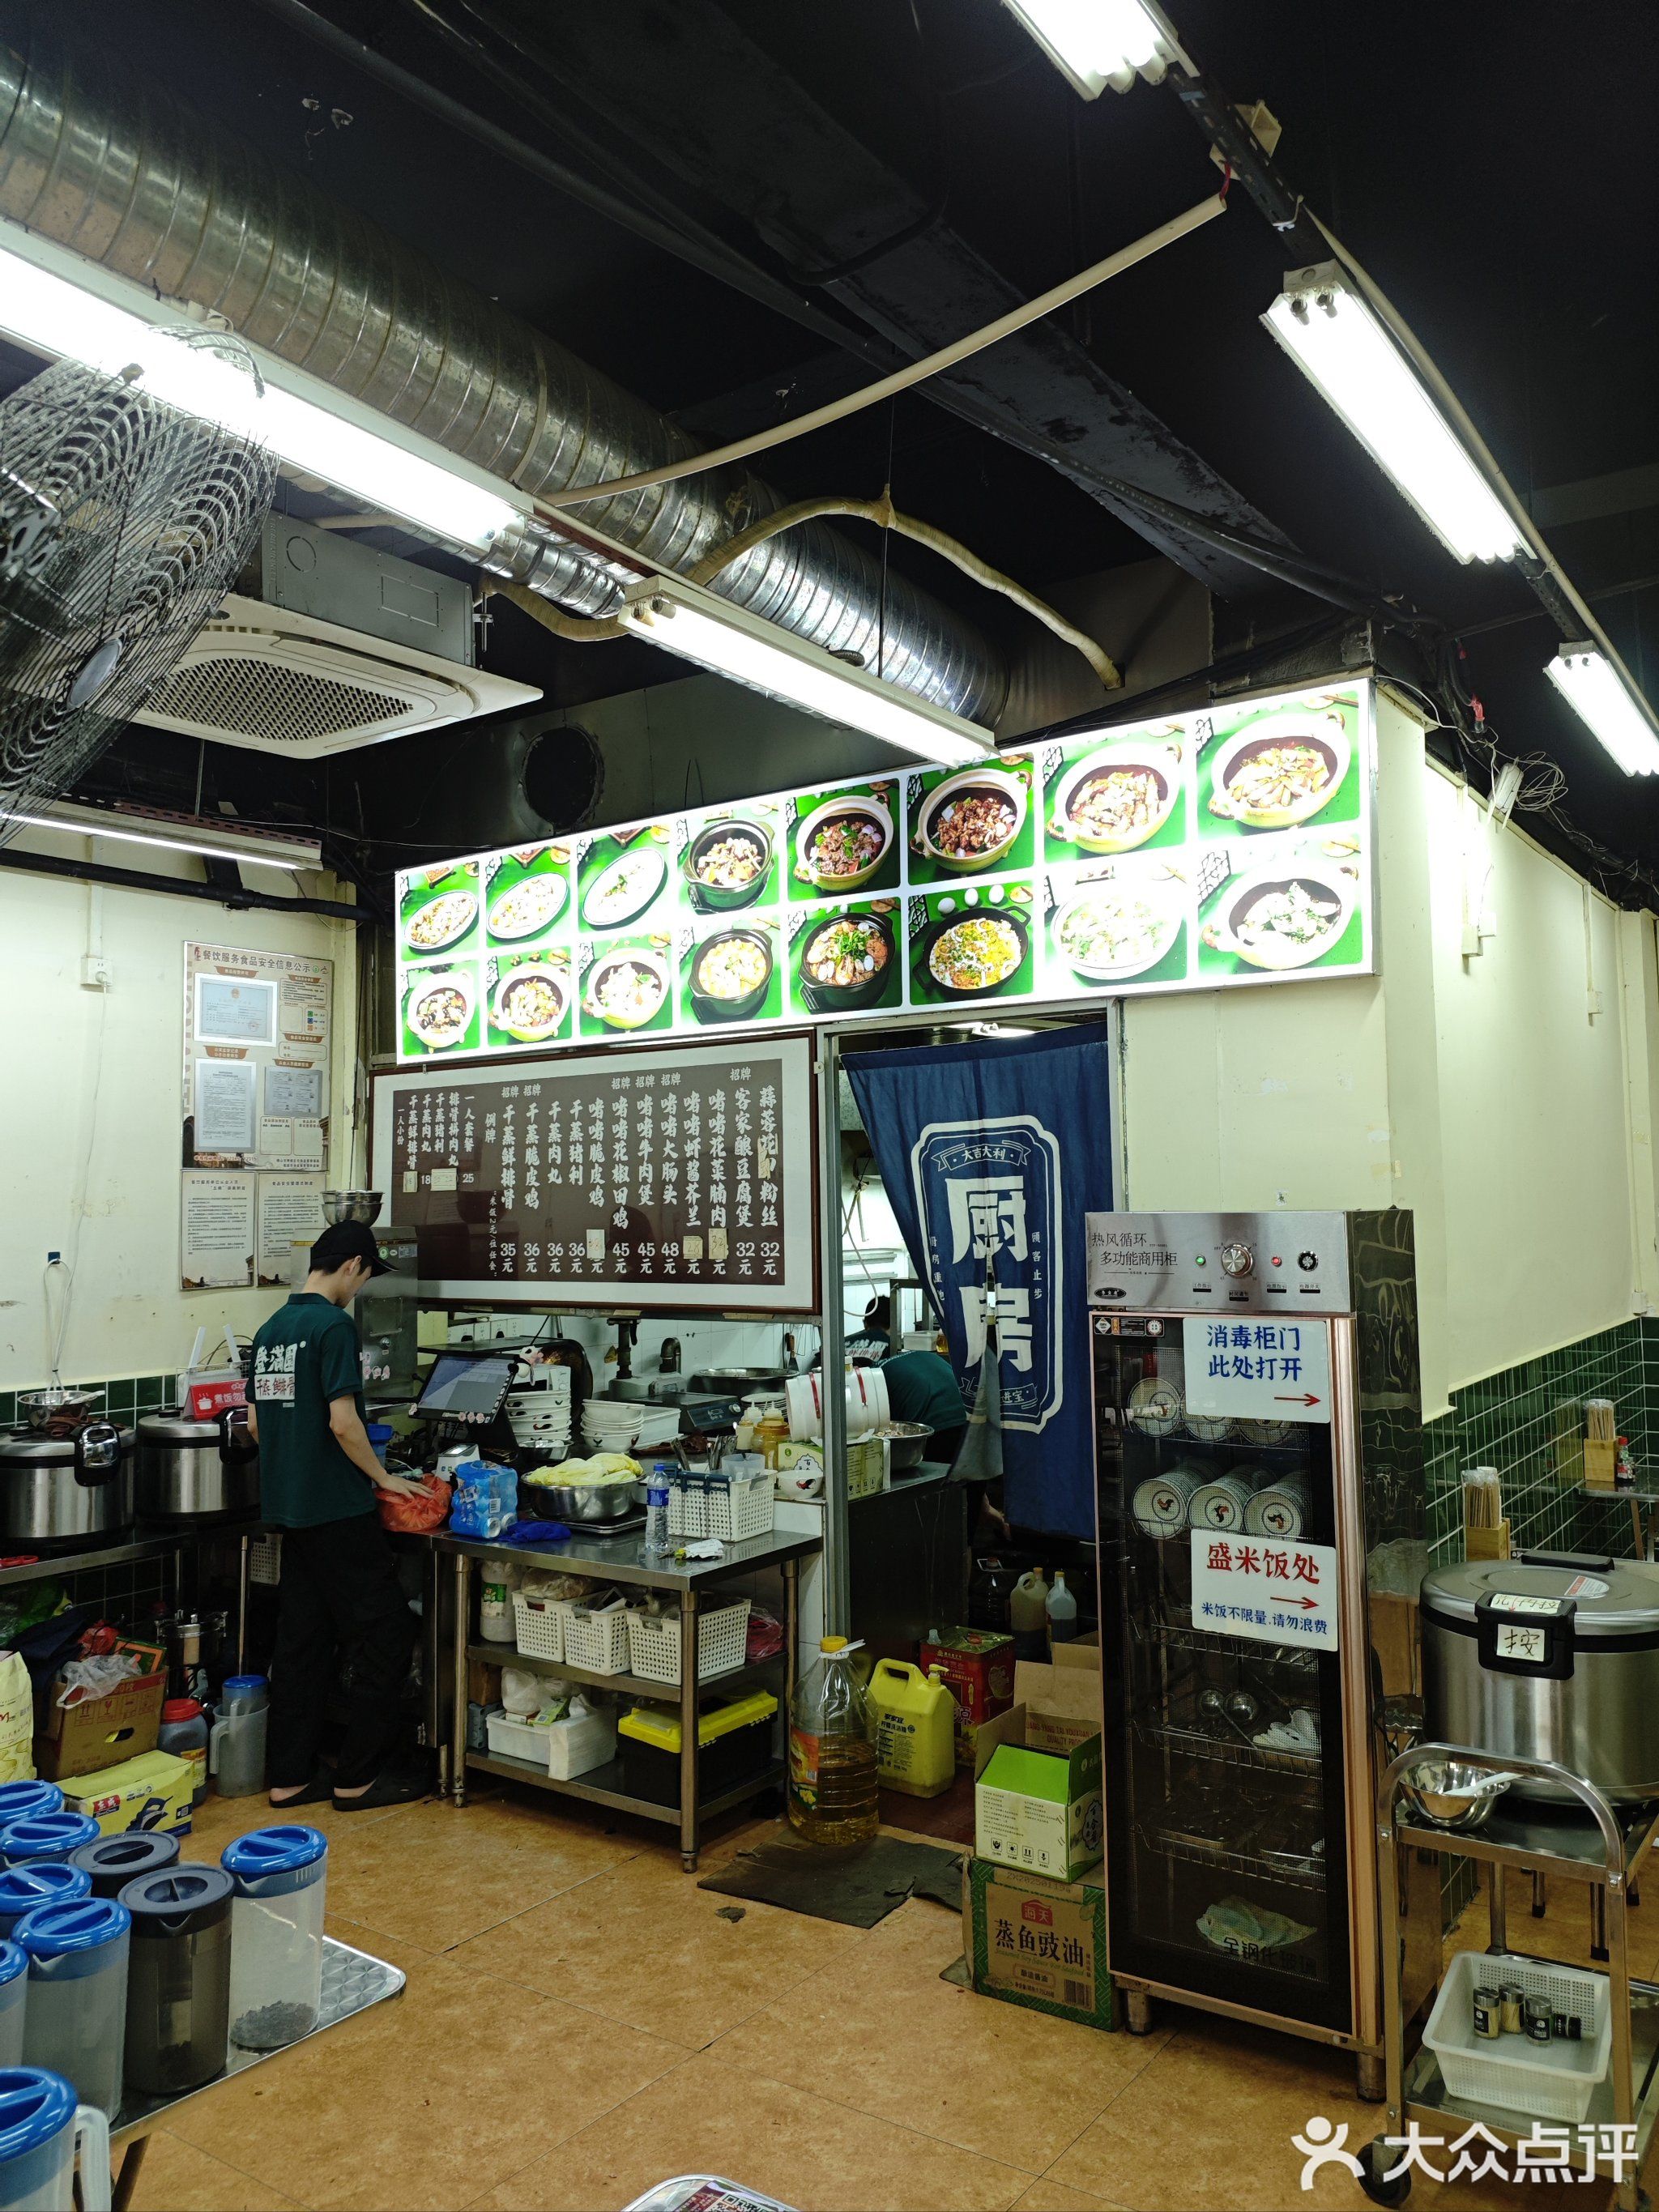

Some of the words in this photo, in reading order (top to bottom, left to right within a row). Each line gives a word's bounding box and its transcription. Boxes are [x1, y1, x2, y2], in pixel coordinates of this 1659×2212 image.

[203, 948, 311, 972] 餐饮服务食品安全信息公示
[611, 1077, 631, 1090] 招牌
[635, 1075, 655, 1089] 招牌
[661, 1072, 681, 1087] 招牌
[730, 1067, 752, 1082] 招牌
[501, 1085, 520, 1098] 招牌
[522, 1083, 542, 1097] 招牌
[396, 1109, 405, 1146] 一人小份
[420, 1093, 432, 1153] 干蒸肉丸
[448, 1092, 460, 1167] 排骨拼肉丸
[464, 1095, 476, 1153] 一人套餐
[484, 1112, 497, 1144] 例牌
[524, 1102, 540, 1210] 干蒸脆皮鸡
[548, 1101, 563, 1186] 干蒸肉丸
[568, 1099, 584, 1186] 干蒸猪利
[961, 1145, 1007, 1162] 大吉大利
[501, 1104, 517, 1211] 干蒸鲜排骨
[420, 1174, 432, 1186] 18
[463, 1173, 475, 1184] 25
[1091, 1232, 1147, 1248] 热风循环
[1031, 1231, 1043, 1300] 顾客止步
[1100, 1251, 1179, 1267] 多功能商用柜
[945, 1174, 1034, 1373] 厨房
[1206, 1324, 1301, 1351] 消毒柜门
[1208, 1354, 1303, 1382] 此处打开
[1206, 1541, 1320, 1585] 盛米饭处
[1503, 1628, 1541, 1657] 按
[1024, 1905, 1050, 1923] 海天
[994, 1918, 1085, 1968] 蒸鱼豉油
